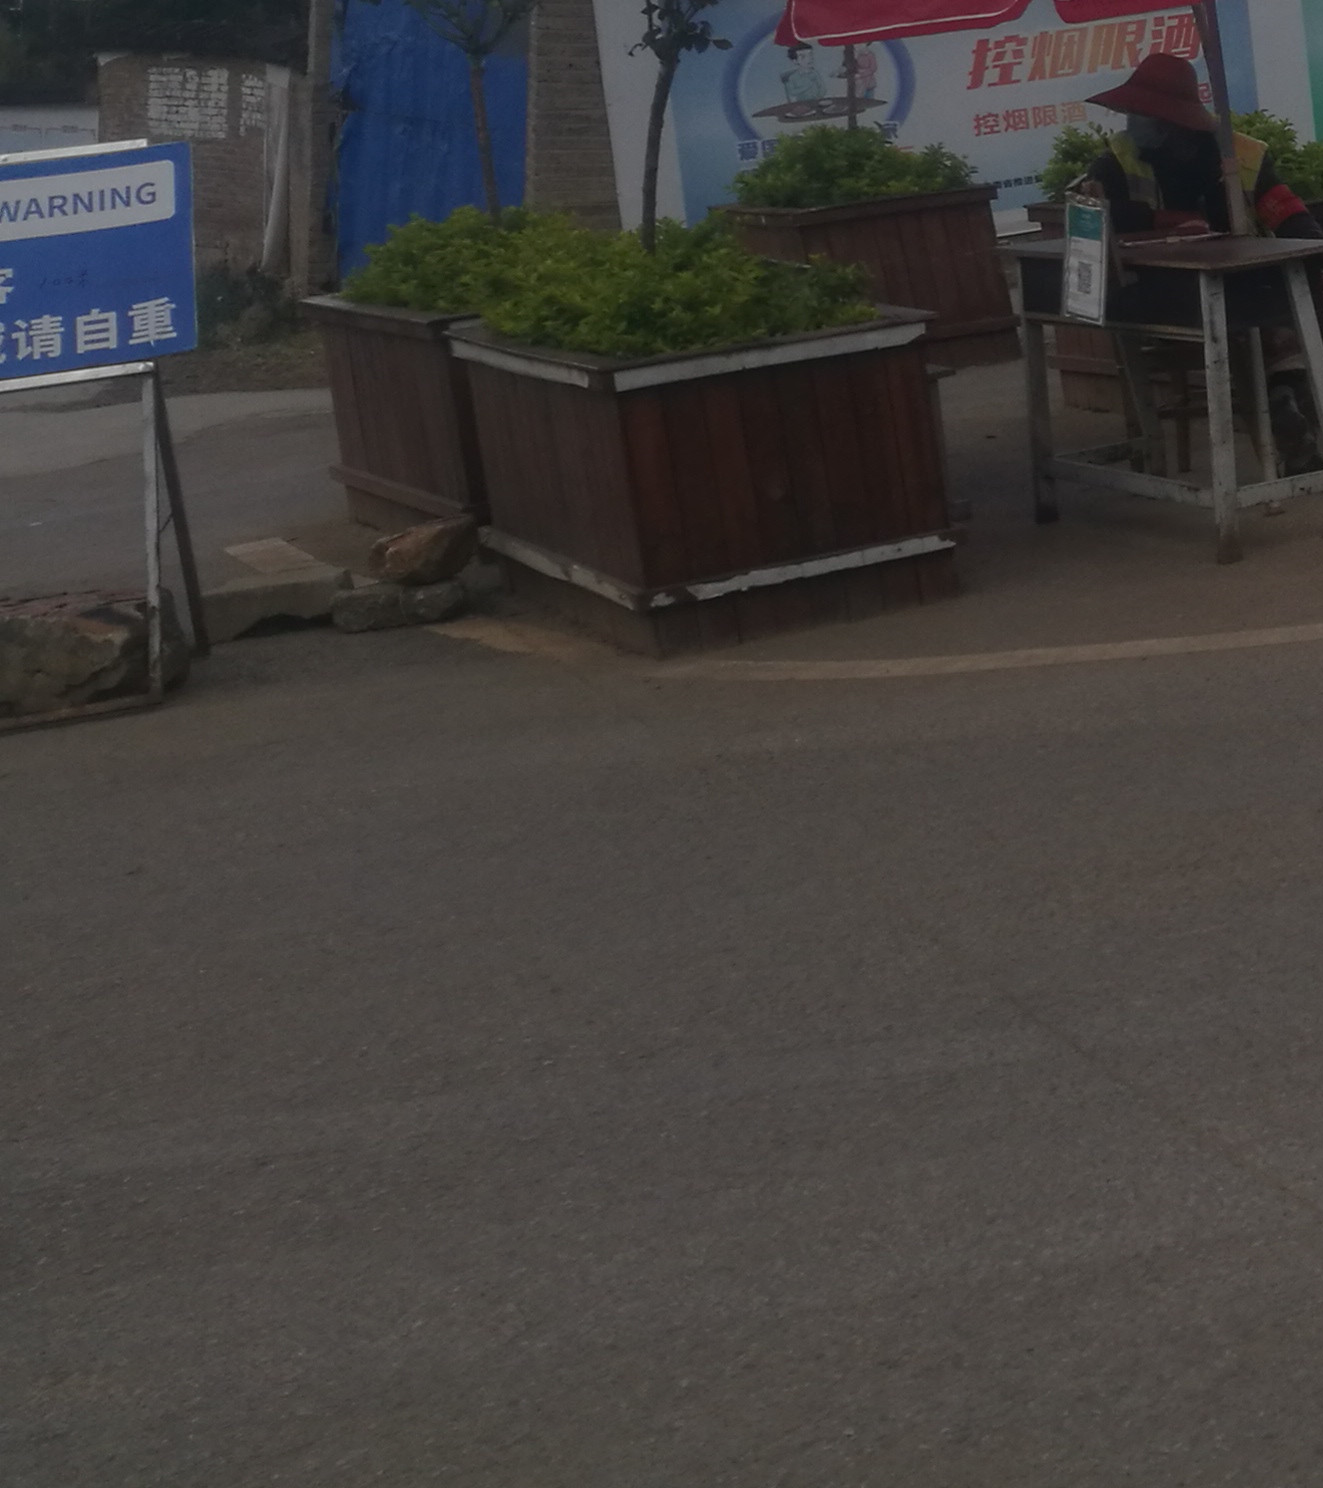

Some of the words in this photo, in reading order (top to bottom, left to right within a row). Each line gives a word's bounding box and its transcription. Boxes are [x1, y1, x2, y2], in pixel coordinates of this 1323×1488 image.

[965, 13, 1202, 91] 控烟限酒
[972, 100, 1088, 137] 控烟限酒
[0, 181, 157, 223] WARNING
